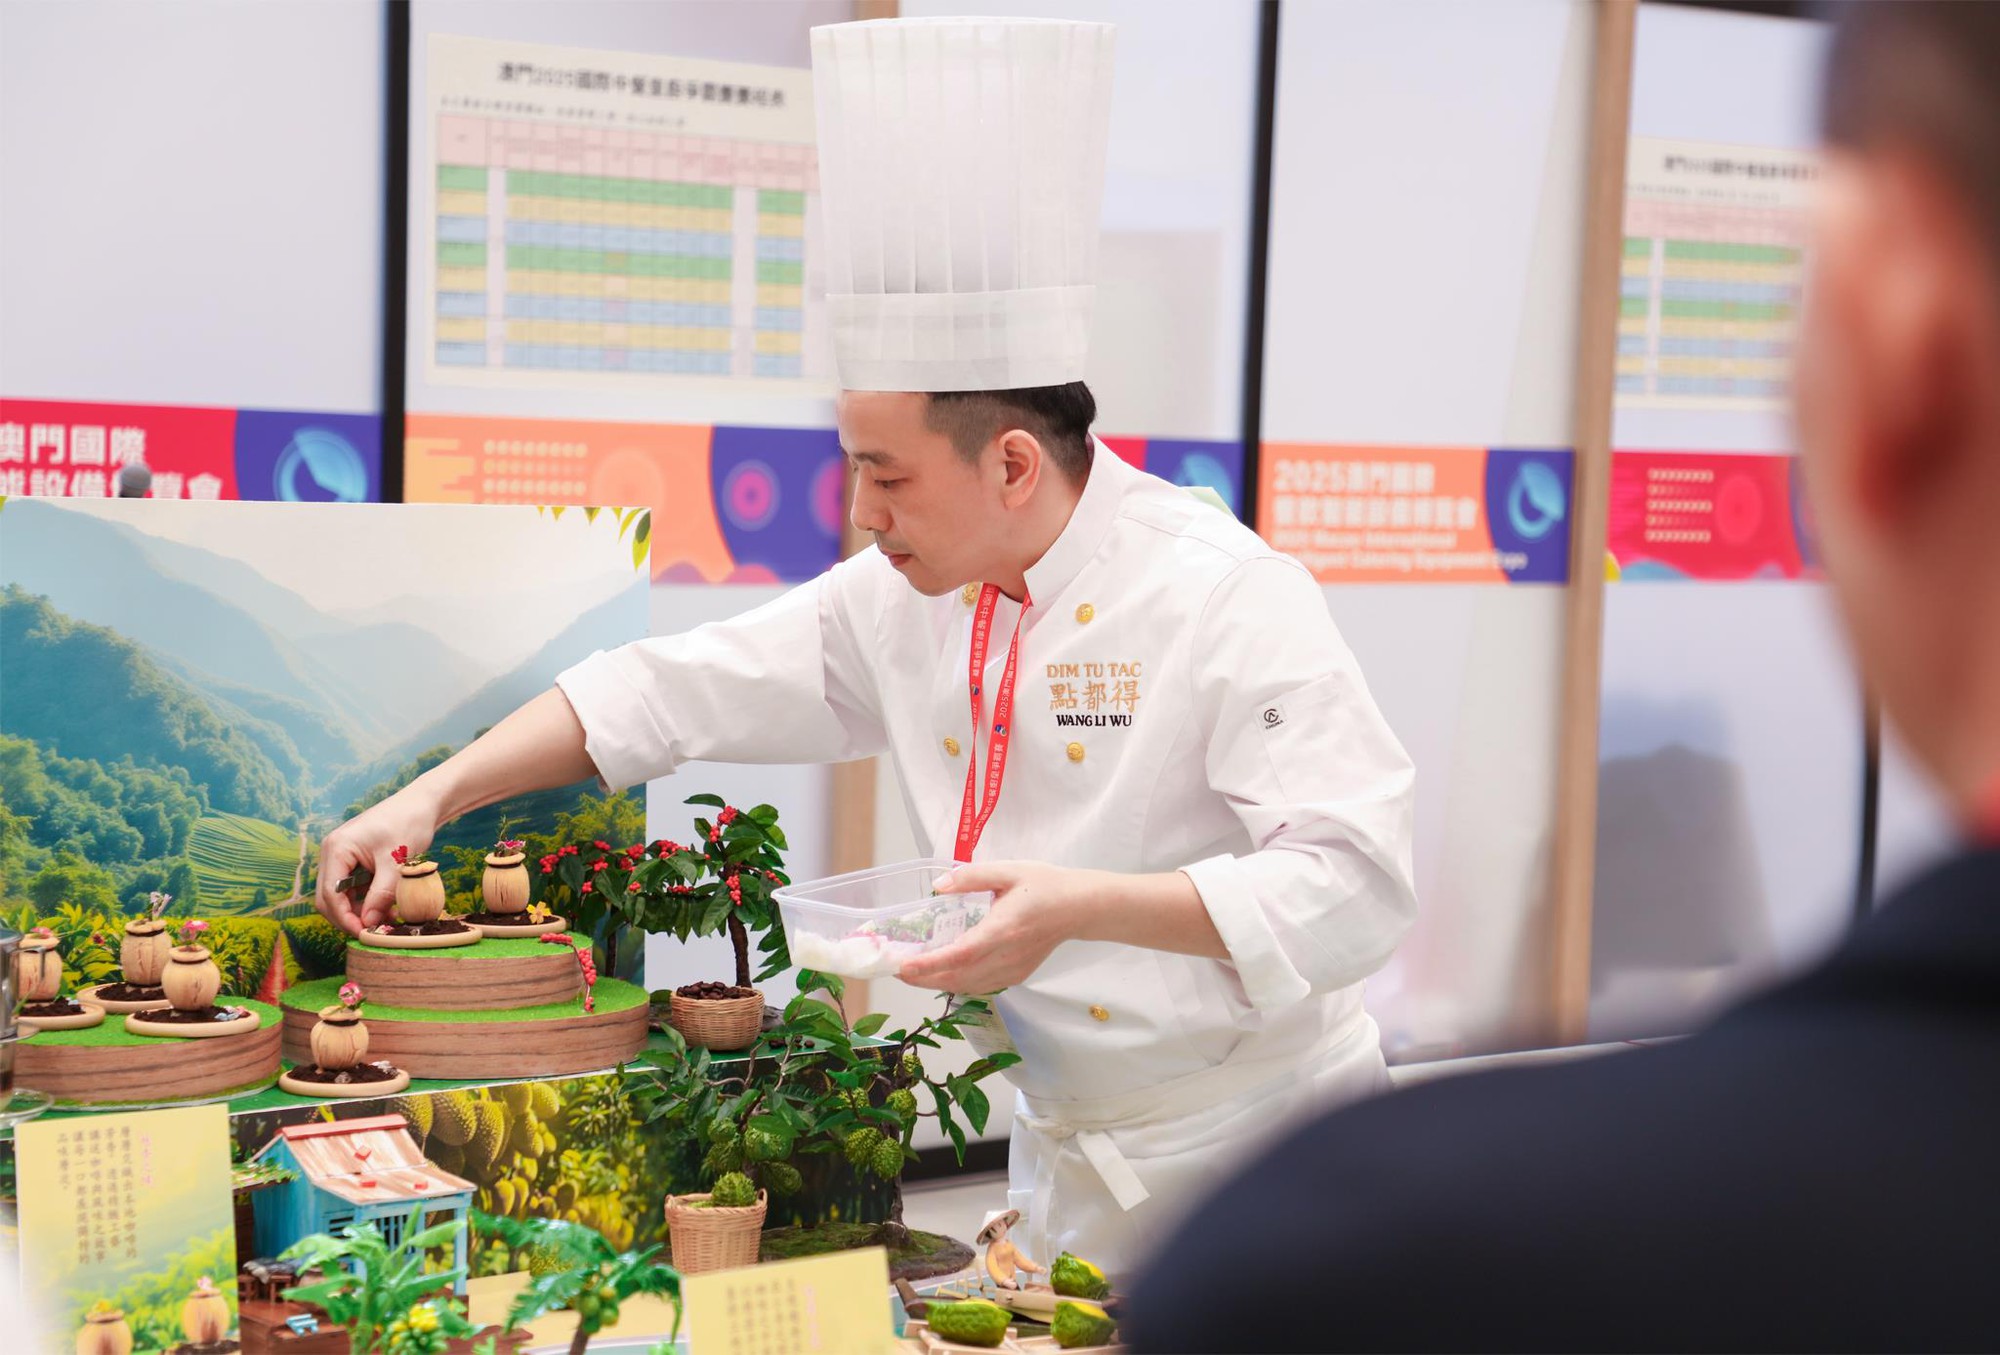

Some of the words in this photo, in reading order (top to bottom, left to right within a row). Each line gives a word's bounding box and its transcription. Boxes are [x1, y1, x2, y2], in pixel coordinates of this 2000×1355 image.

[1047, 663, 1079, 678] DIM
[1083, 663, 1104, 678] TU
[1108, 662, 1142, 678] TAC
[1049, 680, 1141, 713] 點都得
[1056, 714, 1093, 727] WANG
[1094, 715, 1106, 727] LI
[1109, 715, 1132, 727] WU
